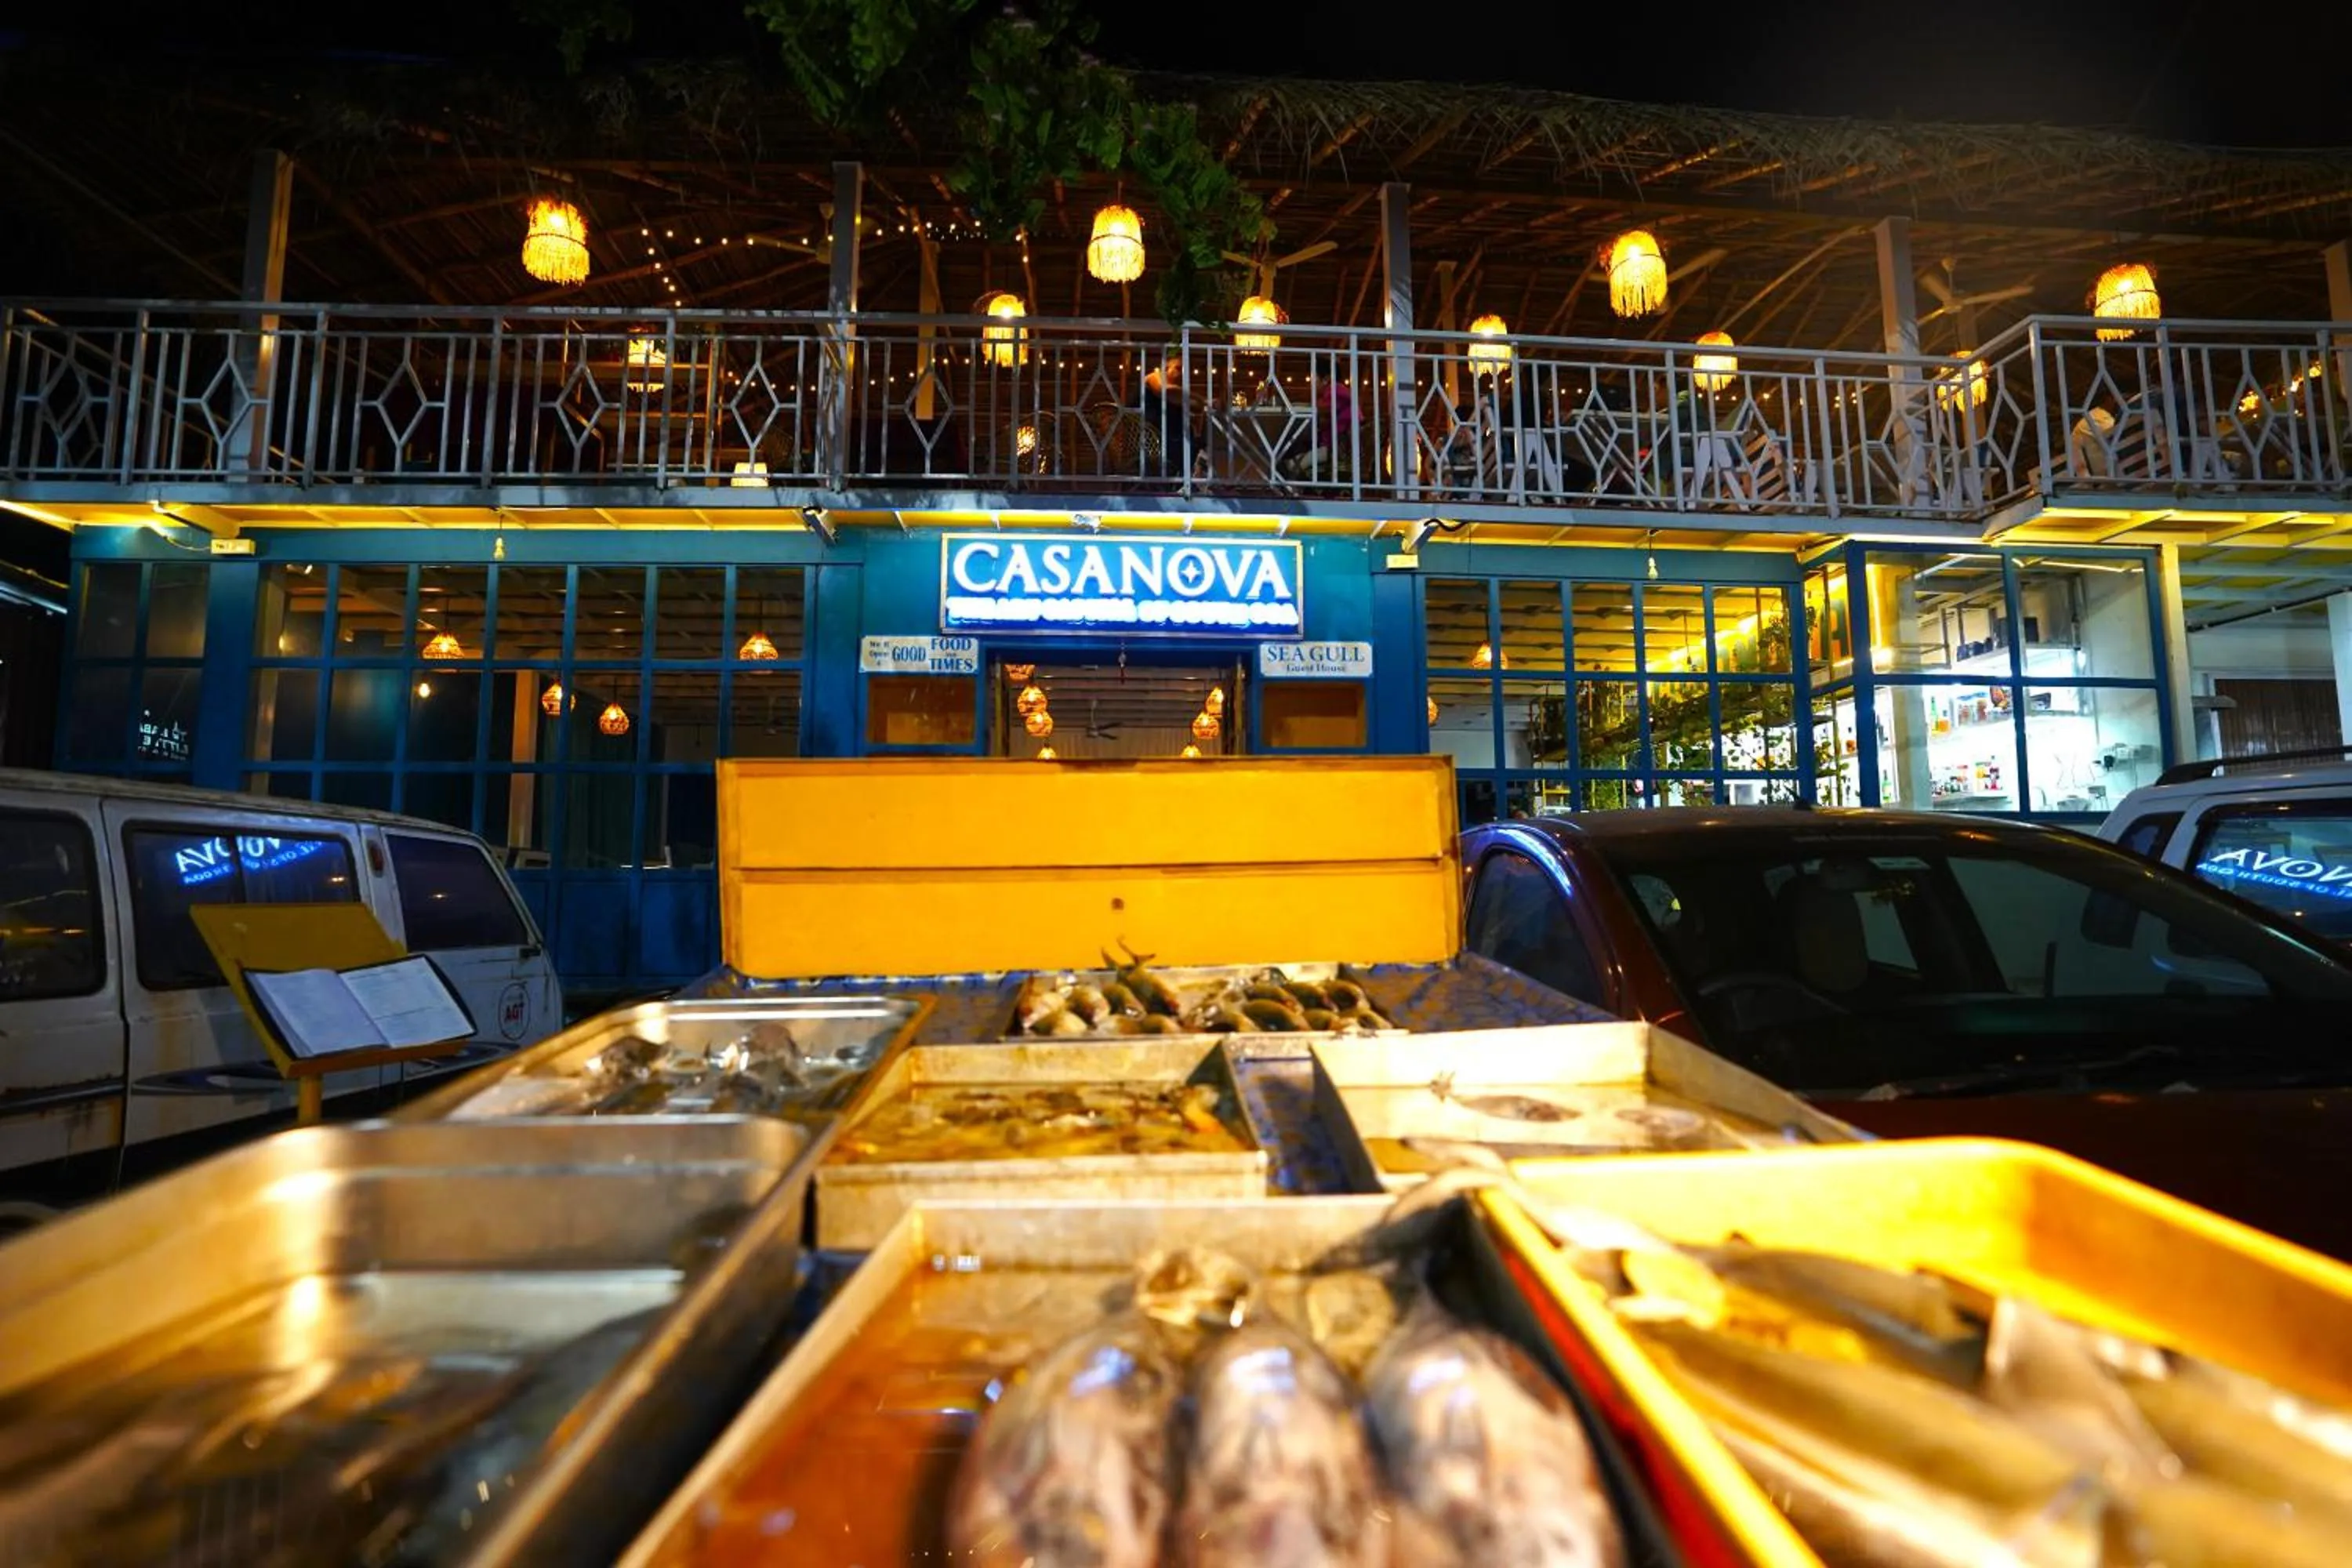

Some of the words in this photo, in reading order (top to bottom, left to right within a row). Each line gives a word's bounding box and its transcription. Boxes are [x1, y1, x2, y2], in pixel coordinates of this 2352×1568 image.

[953, 543, 1293, 599] CASANOVA
[931, 637, 971, 652] FOOD
[892, 646, 927, 662] GOOD
[1267, 646, 1305, 662] SEA
[1309, 646, 1365, 662] GULL
[929, 659, 973, 670] TIMES
